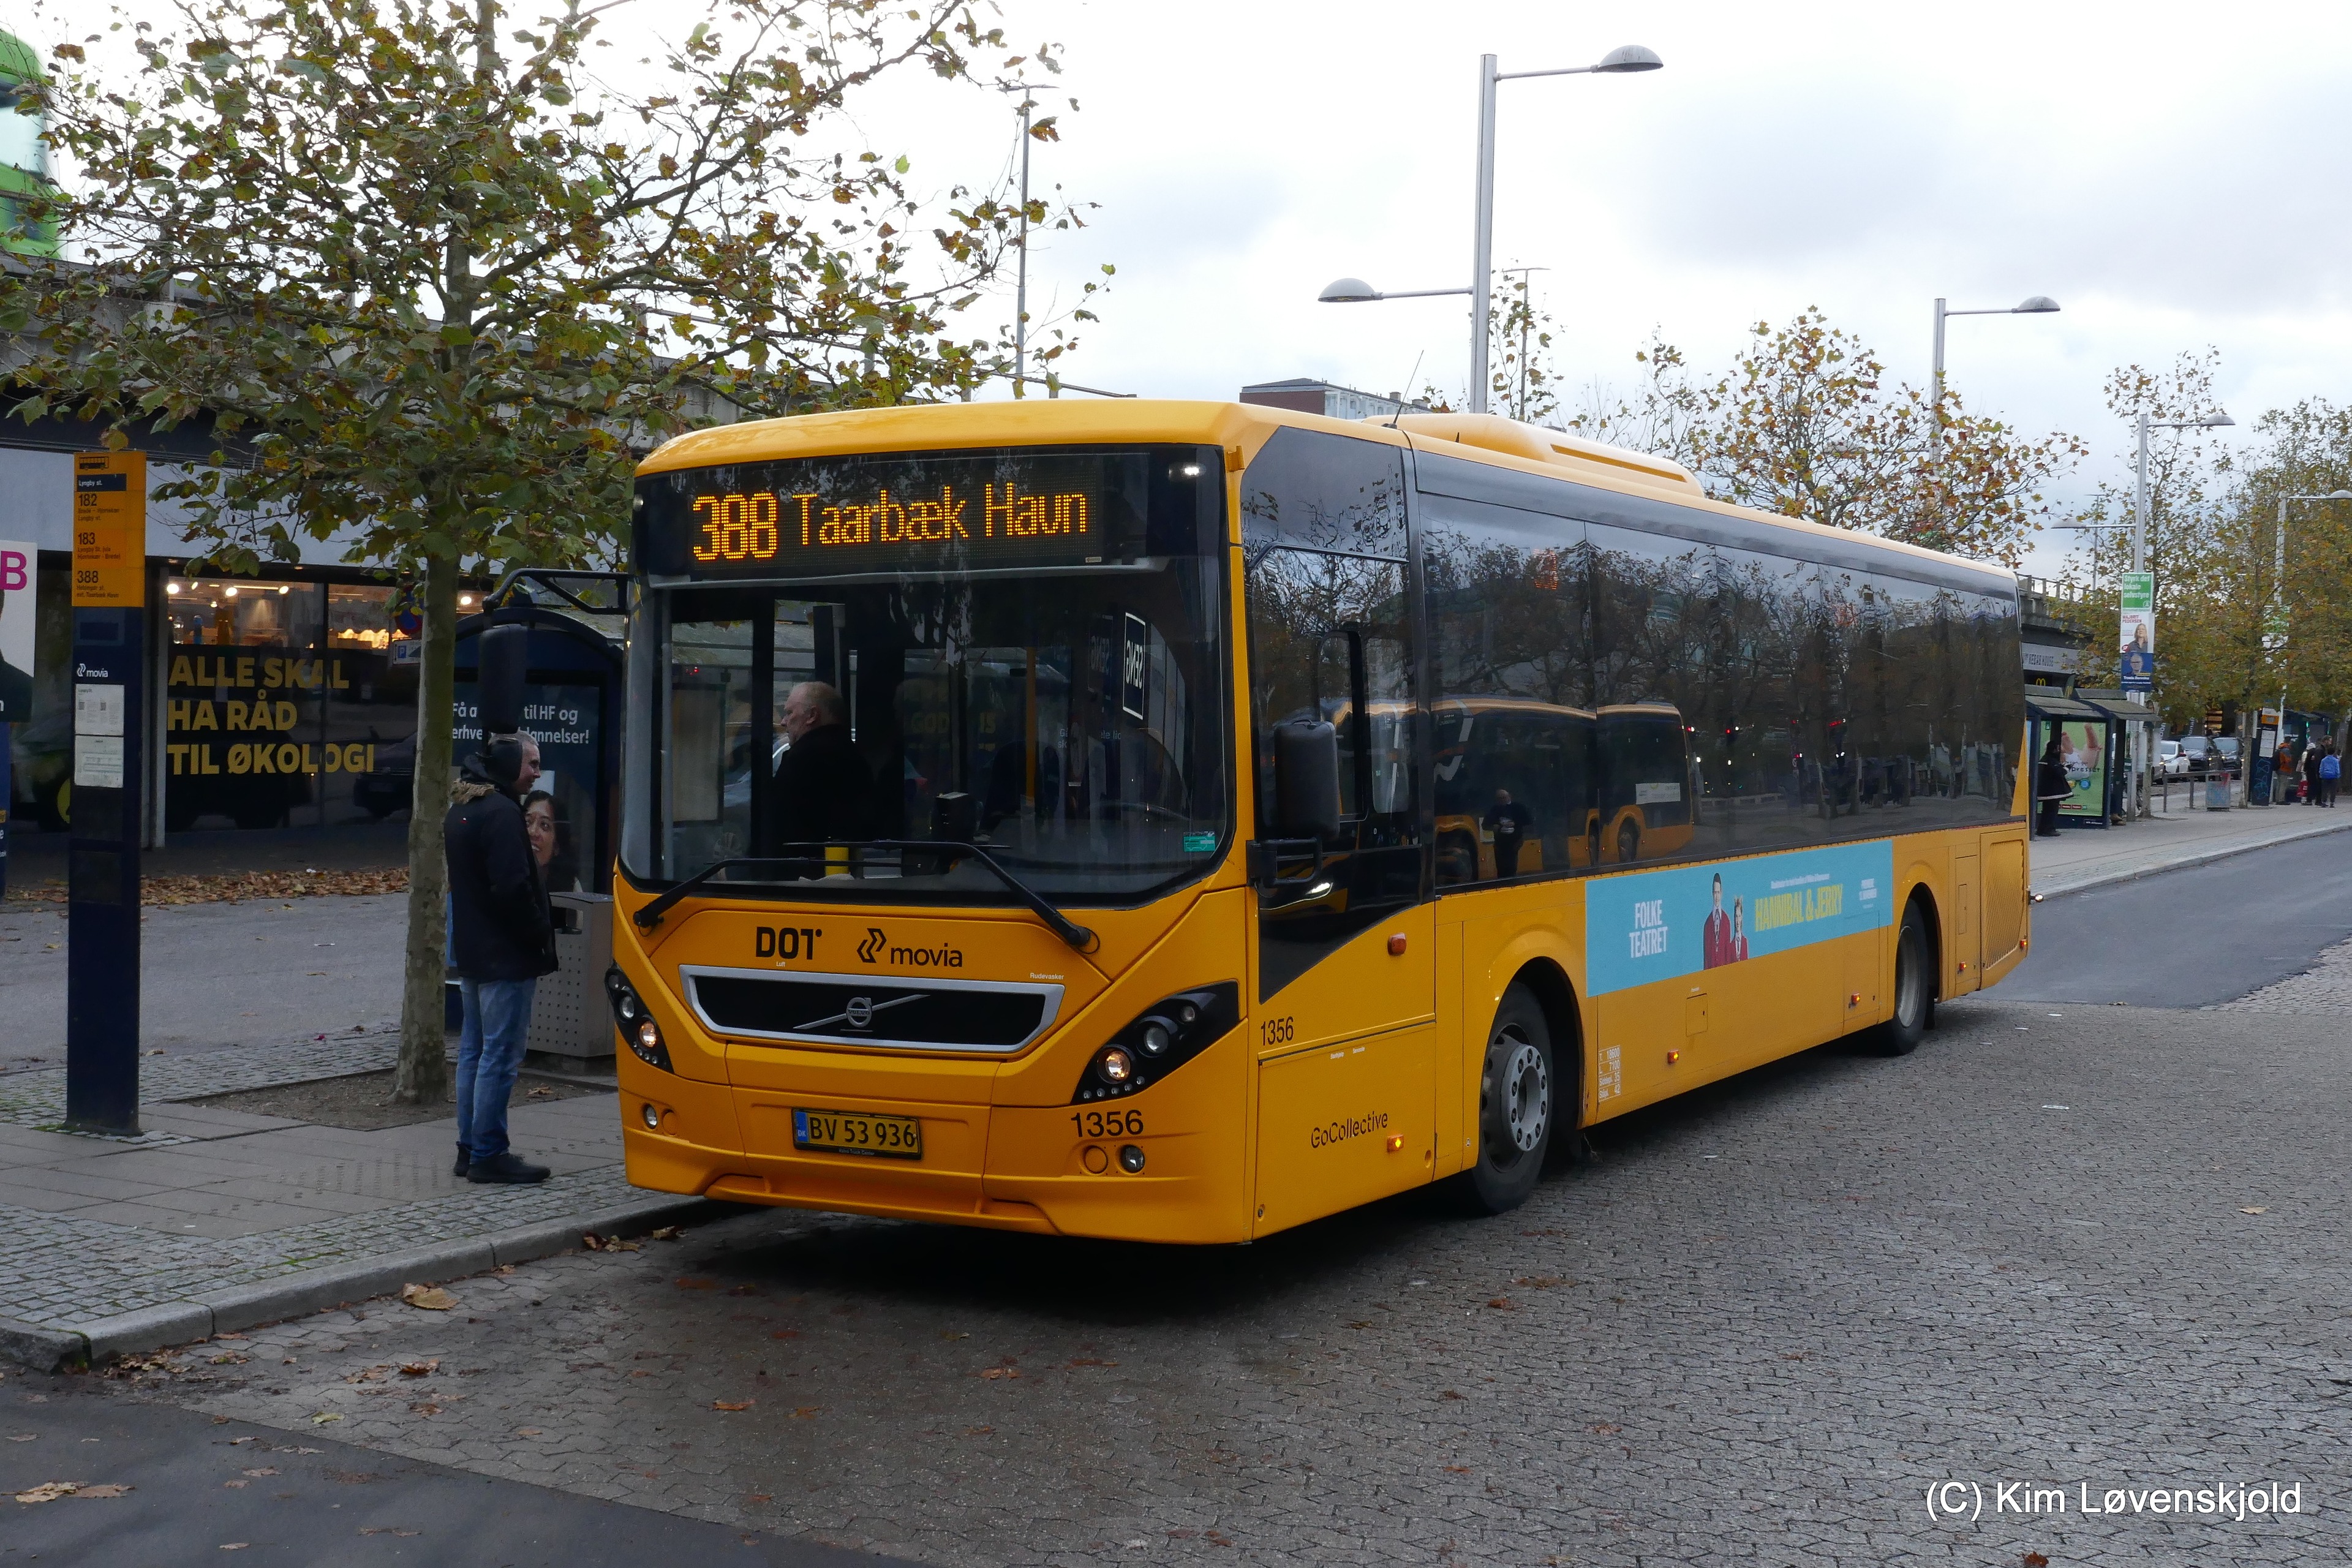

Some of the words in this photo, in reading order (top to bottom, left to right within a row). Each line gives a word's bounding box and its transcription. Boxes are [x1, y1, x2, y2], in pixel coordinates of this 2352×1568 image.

[78, 494, 97, 507] 182
[692, 492, 778, 560] 388
[792, 486, 969, 547] Taarbæk
[78, 532, 96, 545] 183
[77, 571, 99, 583] 388
[86, 668, 108, 677] movia
[168, 655, 255, 688] ALLE
[263, 657, 350, 689] SKAL
[167, 699, 219, 731] HA
[227, 688, 298, 731] RÅD
[524, 704, 537, 720] til
[540, 706, 556, 720] HF
[559, 709, 579, 725] og
[167, 744, 220, 775] TIL
[227, 742, 374, 775] ØKOLOGI
[1635, 899, 1663, 929] FOLKE
[1754, 892, 1804, 932] HANNIBAL
[1805, 888, 1814, 921] &
[1815, 883, 1844, 919] JERRY
[755, 926, 815, 960] DOT
[891, 943, 963, 968] movia
[1629, 926, 1668, 959] TEATRET
[1260, 1016, 1294, 1046] 1356
[1608, 1060, 1620, 1072] 7100
[1615, 1071, 1620, 1082] 35
[809, 1117, 837, 1142] BV
[845, 1119, 869, 1144] 53
[875, 1121, 916, 1148] 936
[1071, 1109, 1144, 1138] 1356
[1311, 1110, 1389, 1149] GoCollective
